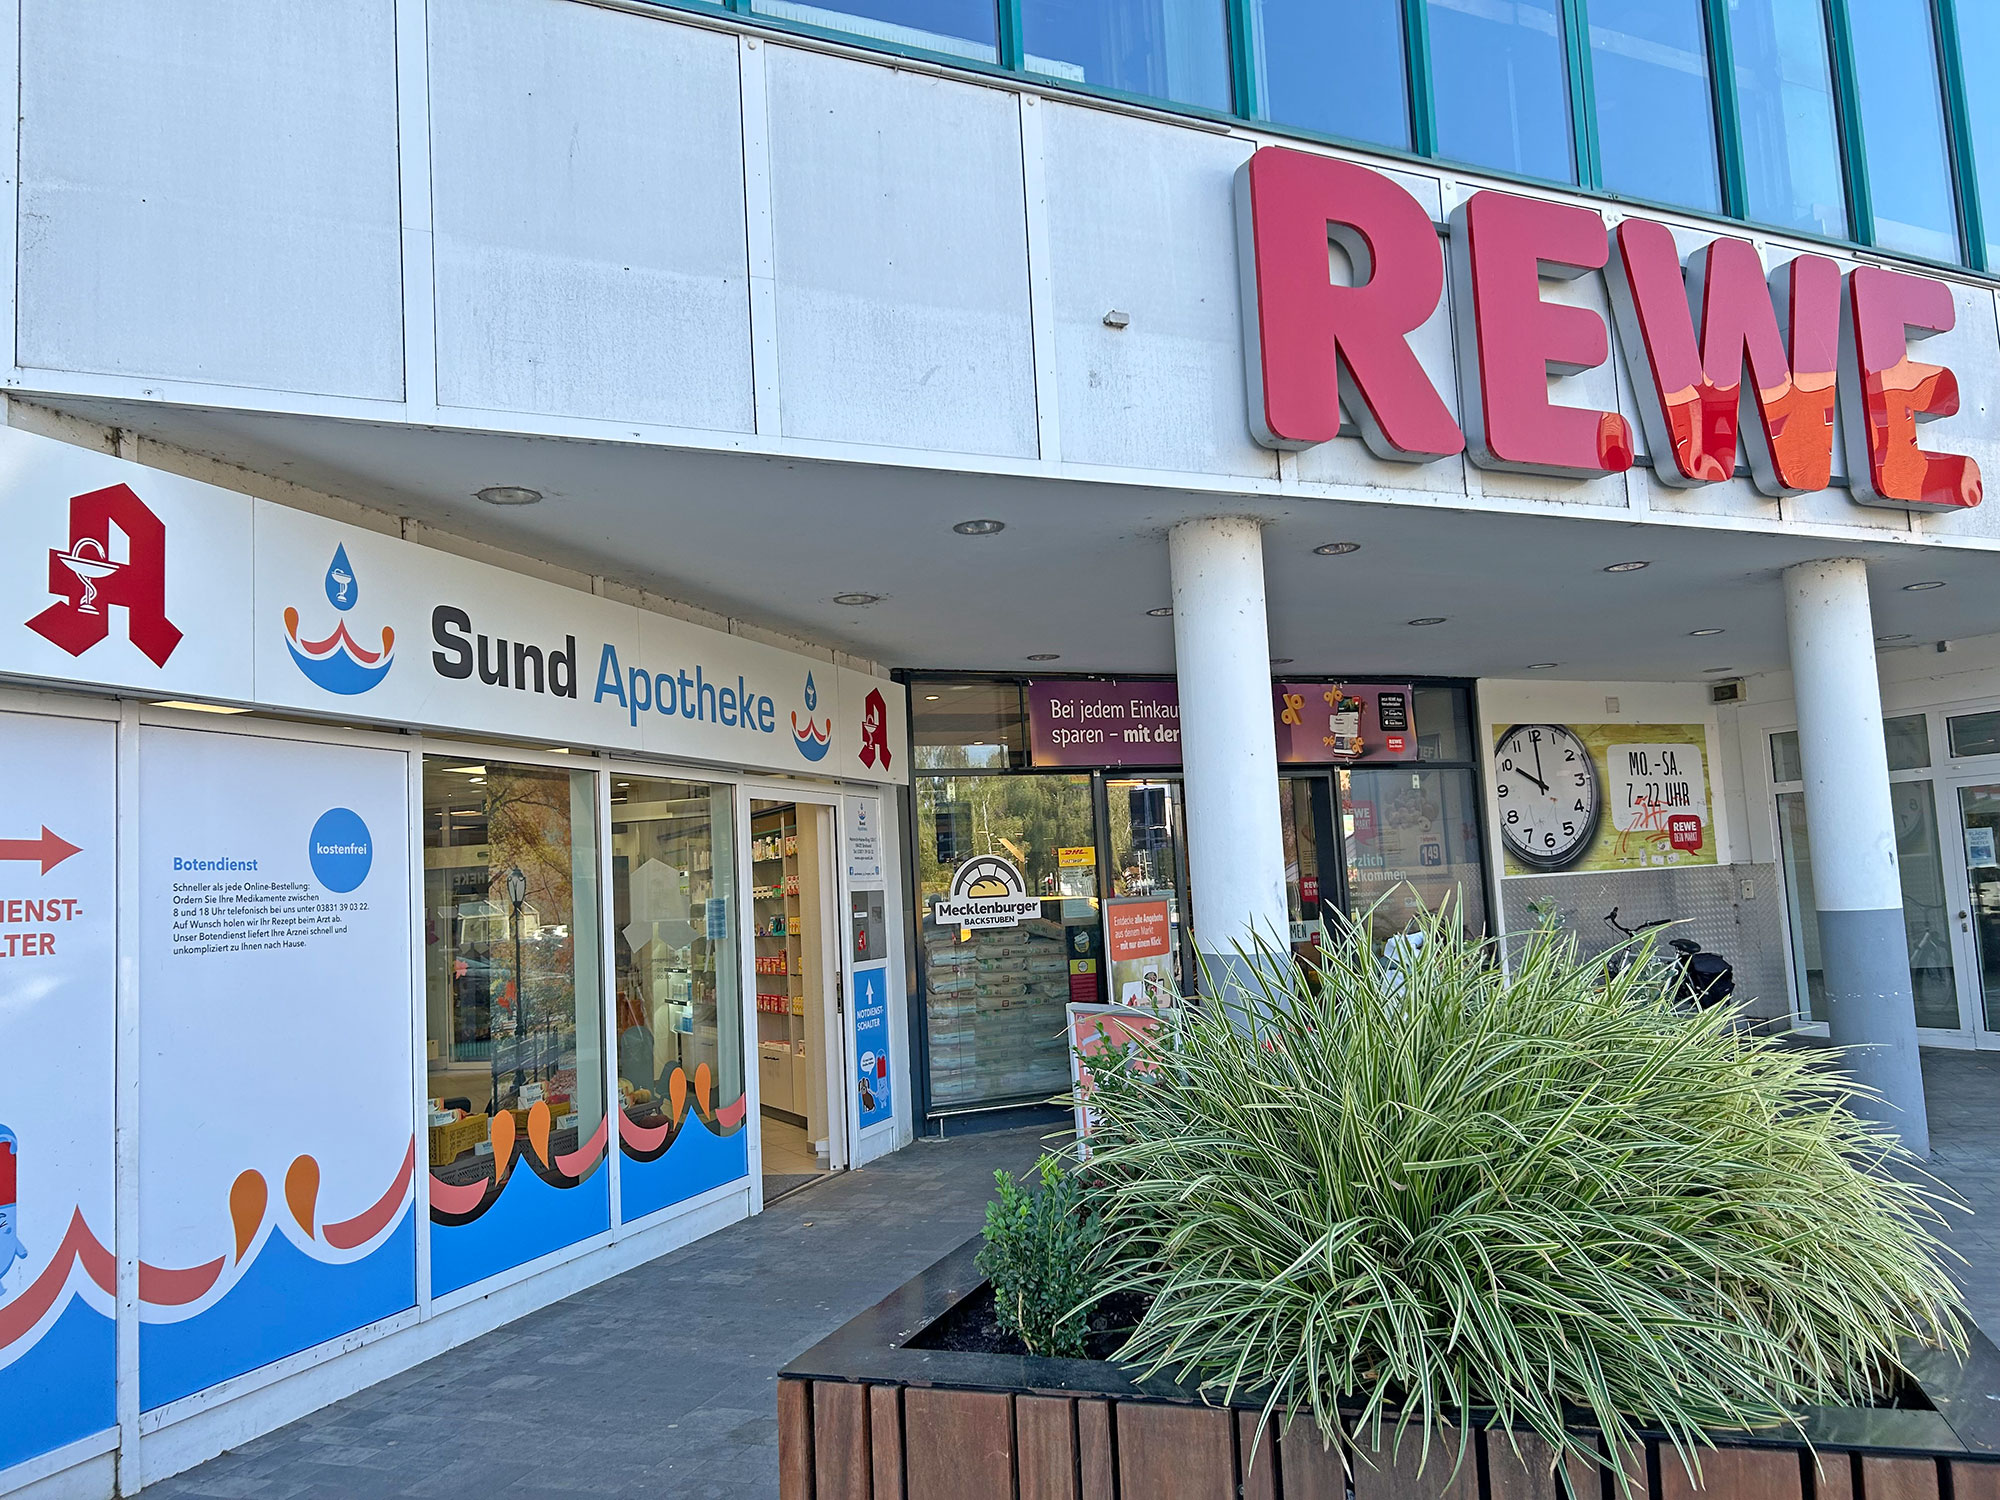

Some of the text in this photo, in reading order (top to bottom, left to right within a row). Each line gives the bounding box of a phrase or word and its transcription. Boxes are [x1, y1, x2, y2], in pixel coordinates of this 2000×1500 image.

[1234, 146, 1982, 513] REWE
[432, 605, 775, 733] Sund Apotheke
[1050, 699, 1180, 723] Bei jedem Einkau
[1052, 728, 1104, 748] sparen
[1124, 724, 1151, 742] mit
[1154, 724, 1179, 742] der
[1564, 749, 1575, 761] 2
[1502, 758, 1513, 771] 10
[1574, 773, 1586, 786] 3
[1497, 784, 1508, 798] 9
[1665, 782, 1690, 806] UHR
[1574, 798, 1585, 812] 4
[1507, 810, 1519, 824] 8
[1562, 821, 1574, 836] 5
[1673, 821, 1697, 831] REWE
[1523, 828, 1533, 843] 7
[1544, 833, 1556, 848] 6
[1674, 832, 1698, 842] DEIN MARKT
[316, 842, 367, 854] kostenfrei
[174, 857, 258, 871] Botendienst
[173, 882, 310, 893] Schneller als jede Online-Bestellung:
[173, 893, 319, 904] Ordern Sie Ihre Medikamente zwischen
[173, 908, 179, 917] 8
[181, 908, 197, 917] und
[199, 907, 209, 916] 18
[212, 907, 225, 916] Uhr
[227, 906, 268, 915] telefonisch
[270, 905, 281, 913] bei
[297, 905, 315, 913] unter
[317, 904, 337, 912] 03831
[340, 903, 348, 911] 39
[350, 903, 358, 911] 03
[360, 903, 369, 911] 22.
[939, 902, 1038, 917] Mecklenburger
[173, 915, 342, 929] Auf Wunsch holen wir Ihr Rezept beim Arzt ab.
[964, 916, 1015, 926] BACKSTUBEN
[1143, 913, 1163, 924] Angebote
[173, 925, 347, 942] Unser Botendienst liefert Ihre Arznei schnell und
[173, 940, 306, 955] unkompliziert zu Ihnen nach Hause.
[857, 1006, 883, 1019] NOTDIENST-
[857, 1018, 880, 1031] SCHALTER
